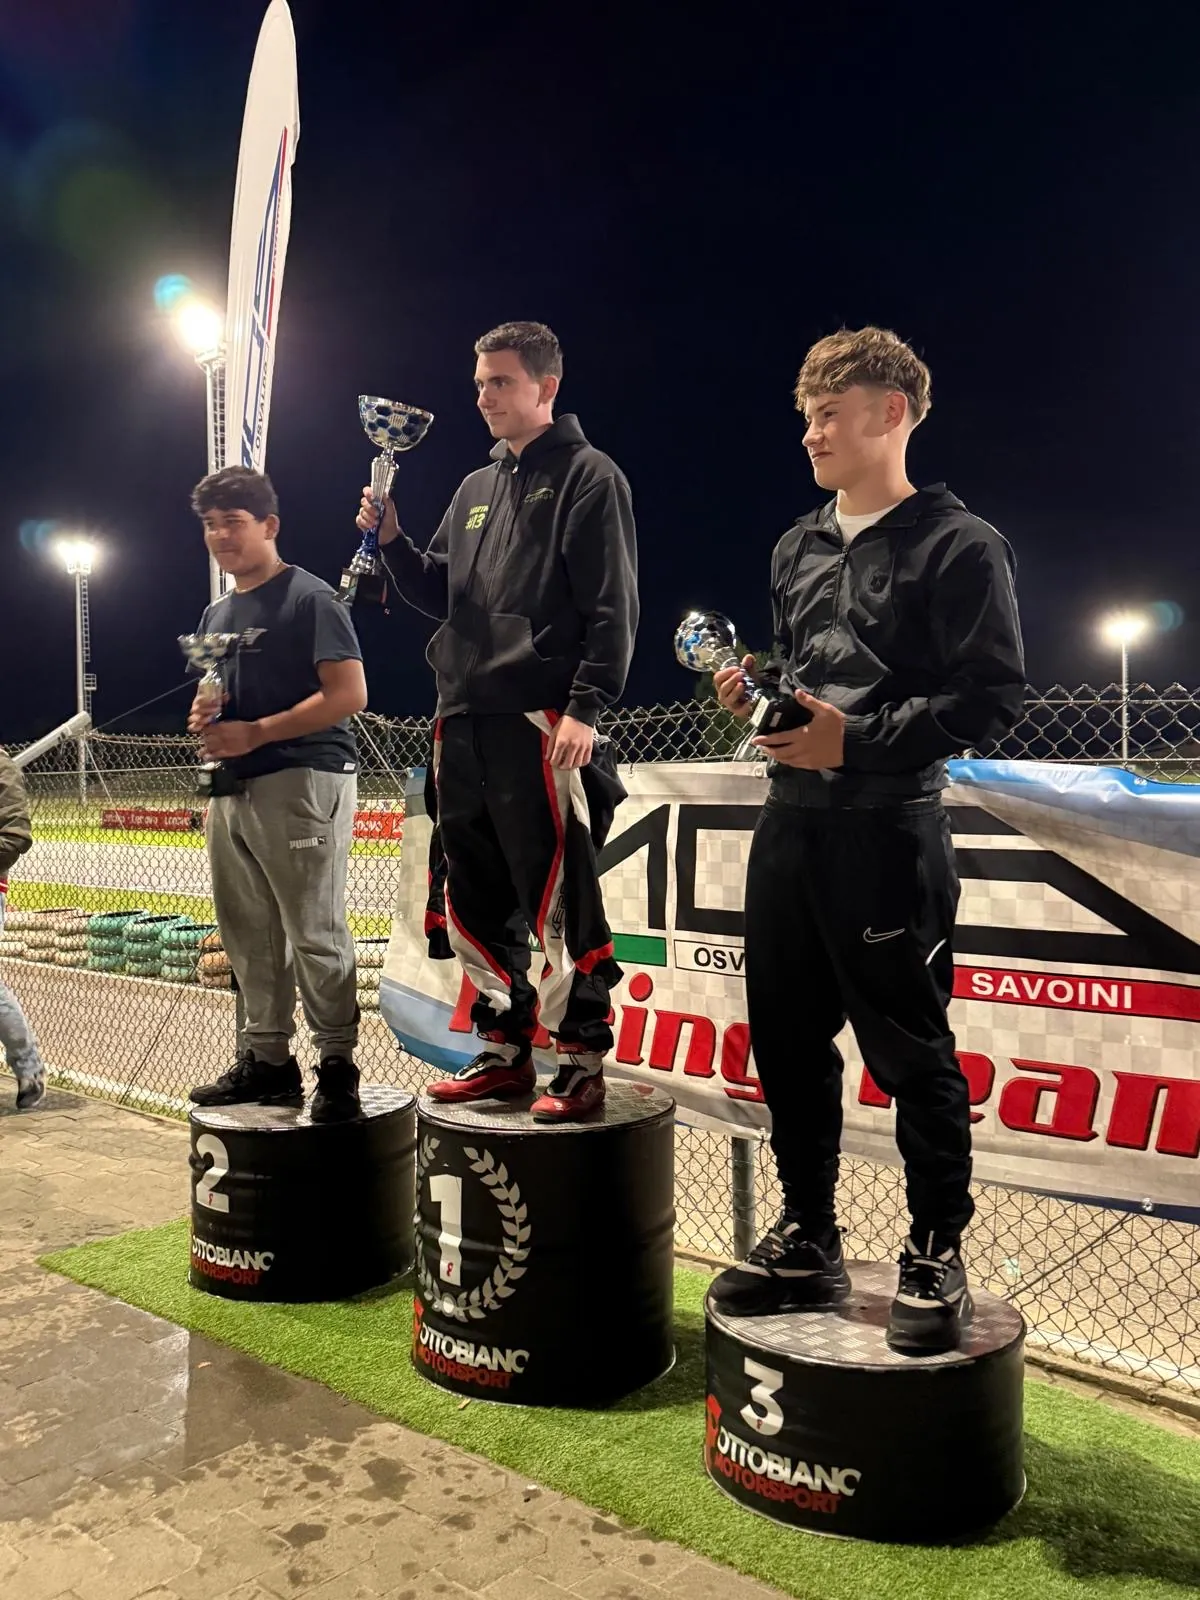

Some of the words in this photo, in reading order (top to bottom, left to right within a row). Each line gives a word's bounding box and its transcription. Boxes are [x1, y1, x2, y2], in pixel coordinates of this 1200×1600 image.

[255, 361, 268, 449] OSVALDO
[289, 837, 319, 850] PUMA
[694, 947, 746, 971] OSV
[971, 972, 1132, 1009] SAVOINI
[196, 1133, 230, 1214] 2
[429, 1173, 463, 1287] 1
[740, 1356, 784, 1437] 3
[714, 1452, 844, 1514] MOTORSPORT
